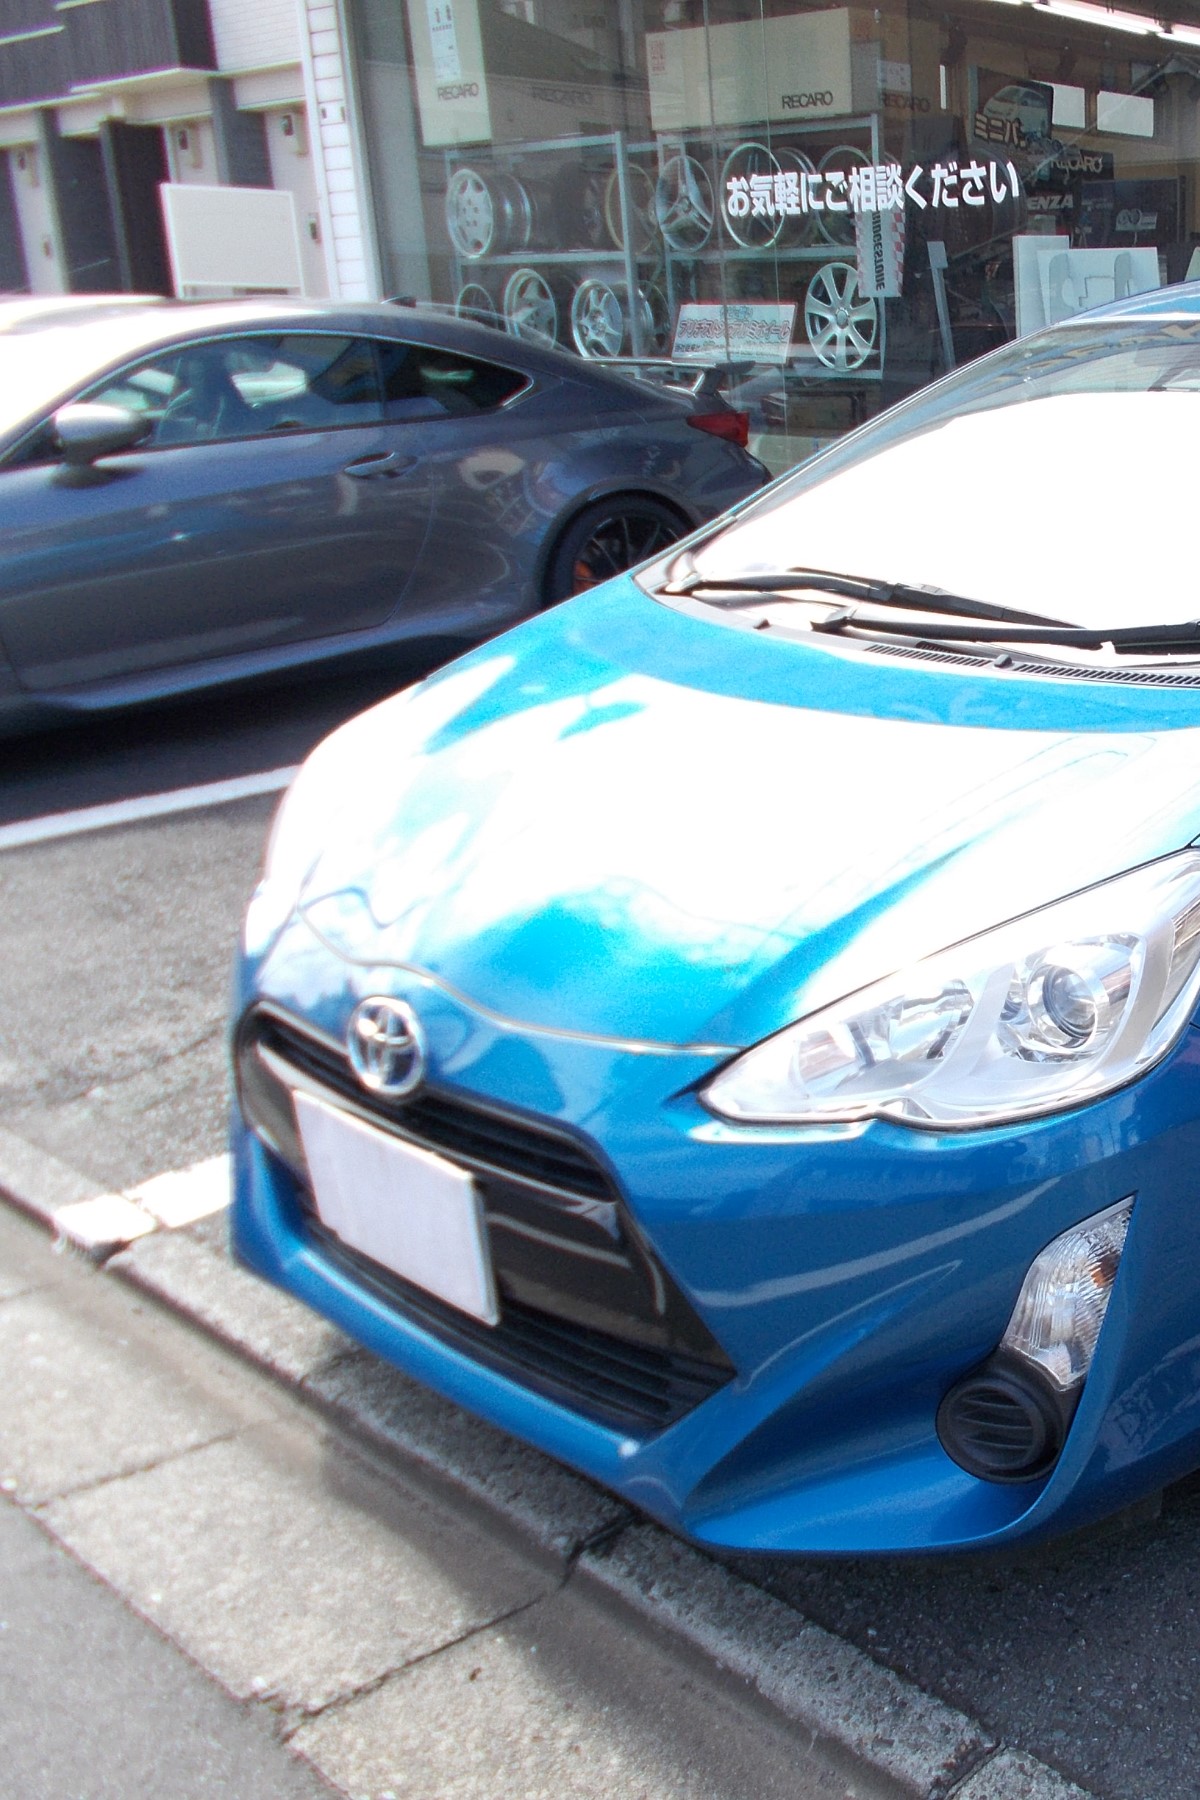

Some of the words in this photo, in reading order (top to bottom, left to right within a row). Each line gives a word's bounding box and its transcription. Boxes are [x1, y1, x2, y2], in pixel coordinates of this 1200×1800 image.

[437, 82, 479, 101] RECARO
[781, 91, 834, 110] RECARO
[882, 92, 931, 112] RECARO
[974, 112, 1027, 149] ミニバ
[726, 160, 1020, 217] お気軽にご相談ください
[1027, 194, 1074, 210] ENZA
